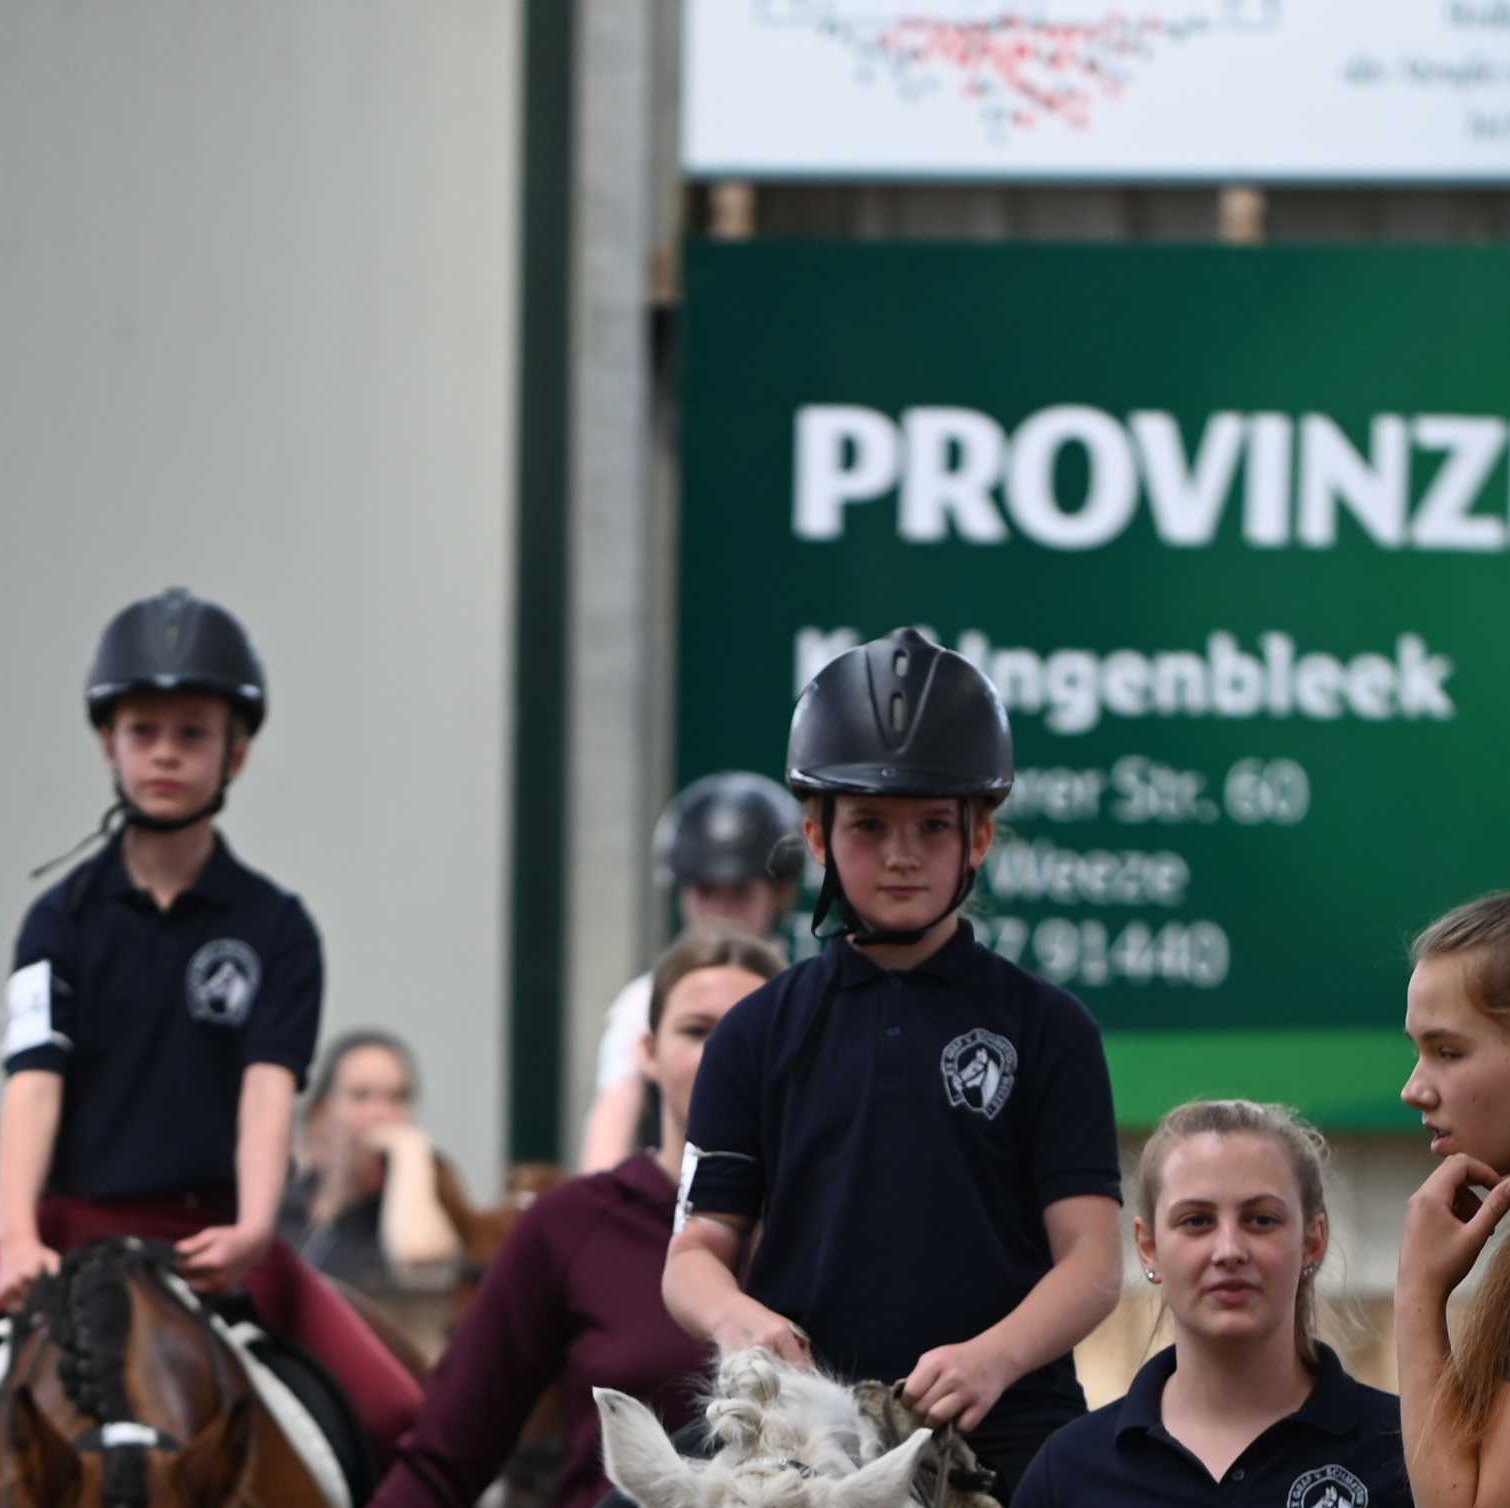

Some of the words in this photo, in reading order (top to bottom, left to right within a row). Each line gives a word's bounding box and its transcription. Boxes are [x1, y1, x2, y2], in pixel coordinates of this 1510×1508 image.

[1111, 754, 1220, 824] Str.
[1223, 756, 1311, 825] 60
[991, 838, 1190, 904] Weeze
[1033, 915, 1232, 988] 91440
